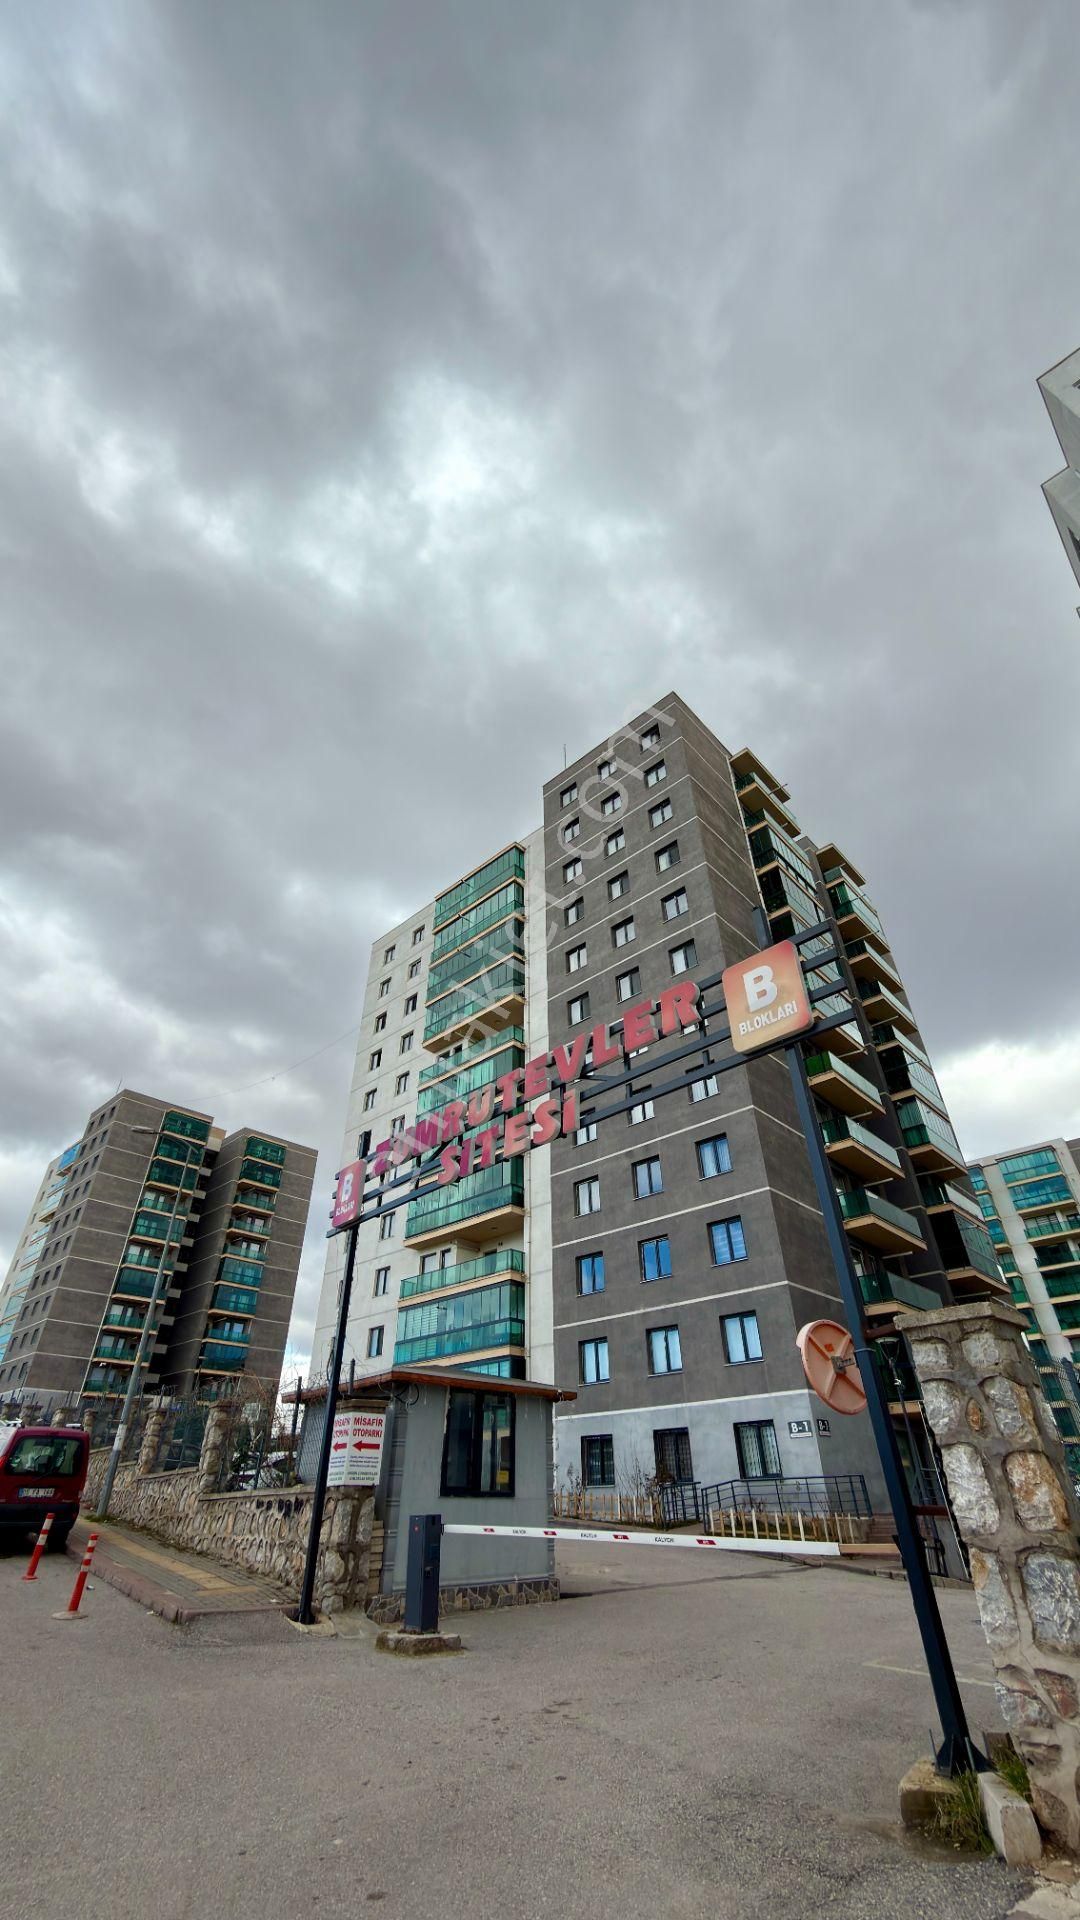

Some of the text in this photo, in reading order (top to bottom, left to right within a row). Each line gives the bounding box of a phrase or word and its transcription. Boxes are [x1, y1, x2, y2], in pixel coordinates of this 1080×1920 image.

[742, 965, 778, 1013] B
[738, 1000, 798, 1036] BLOKLARI
[341, 1173, 353, 1202] B
[352, 1428, 383, 1438] OTOPARKI
[353, 1416, 383, 1427] MİSAFİR
